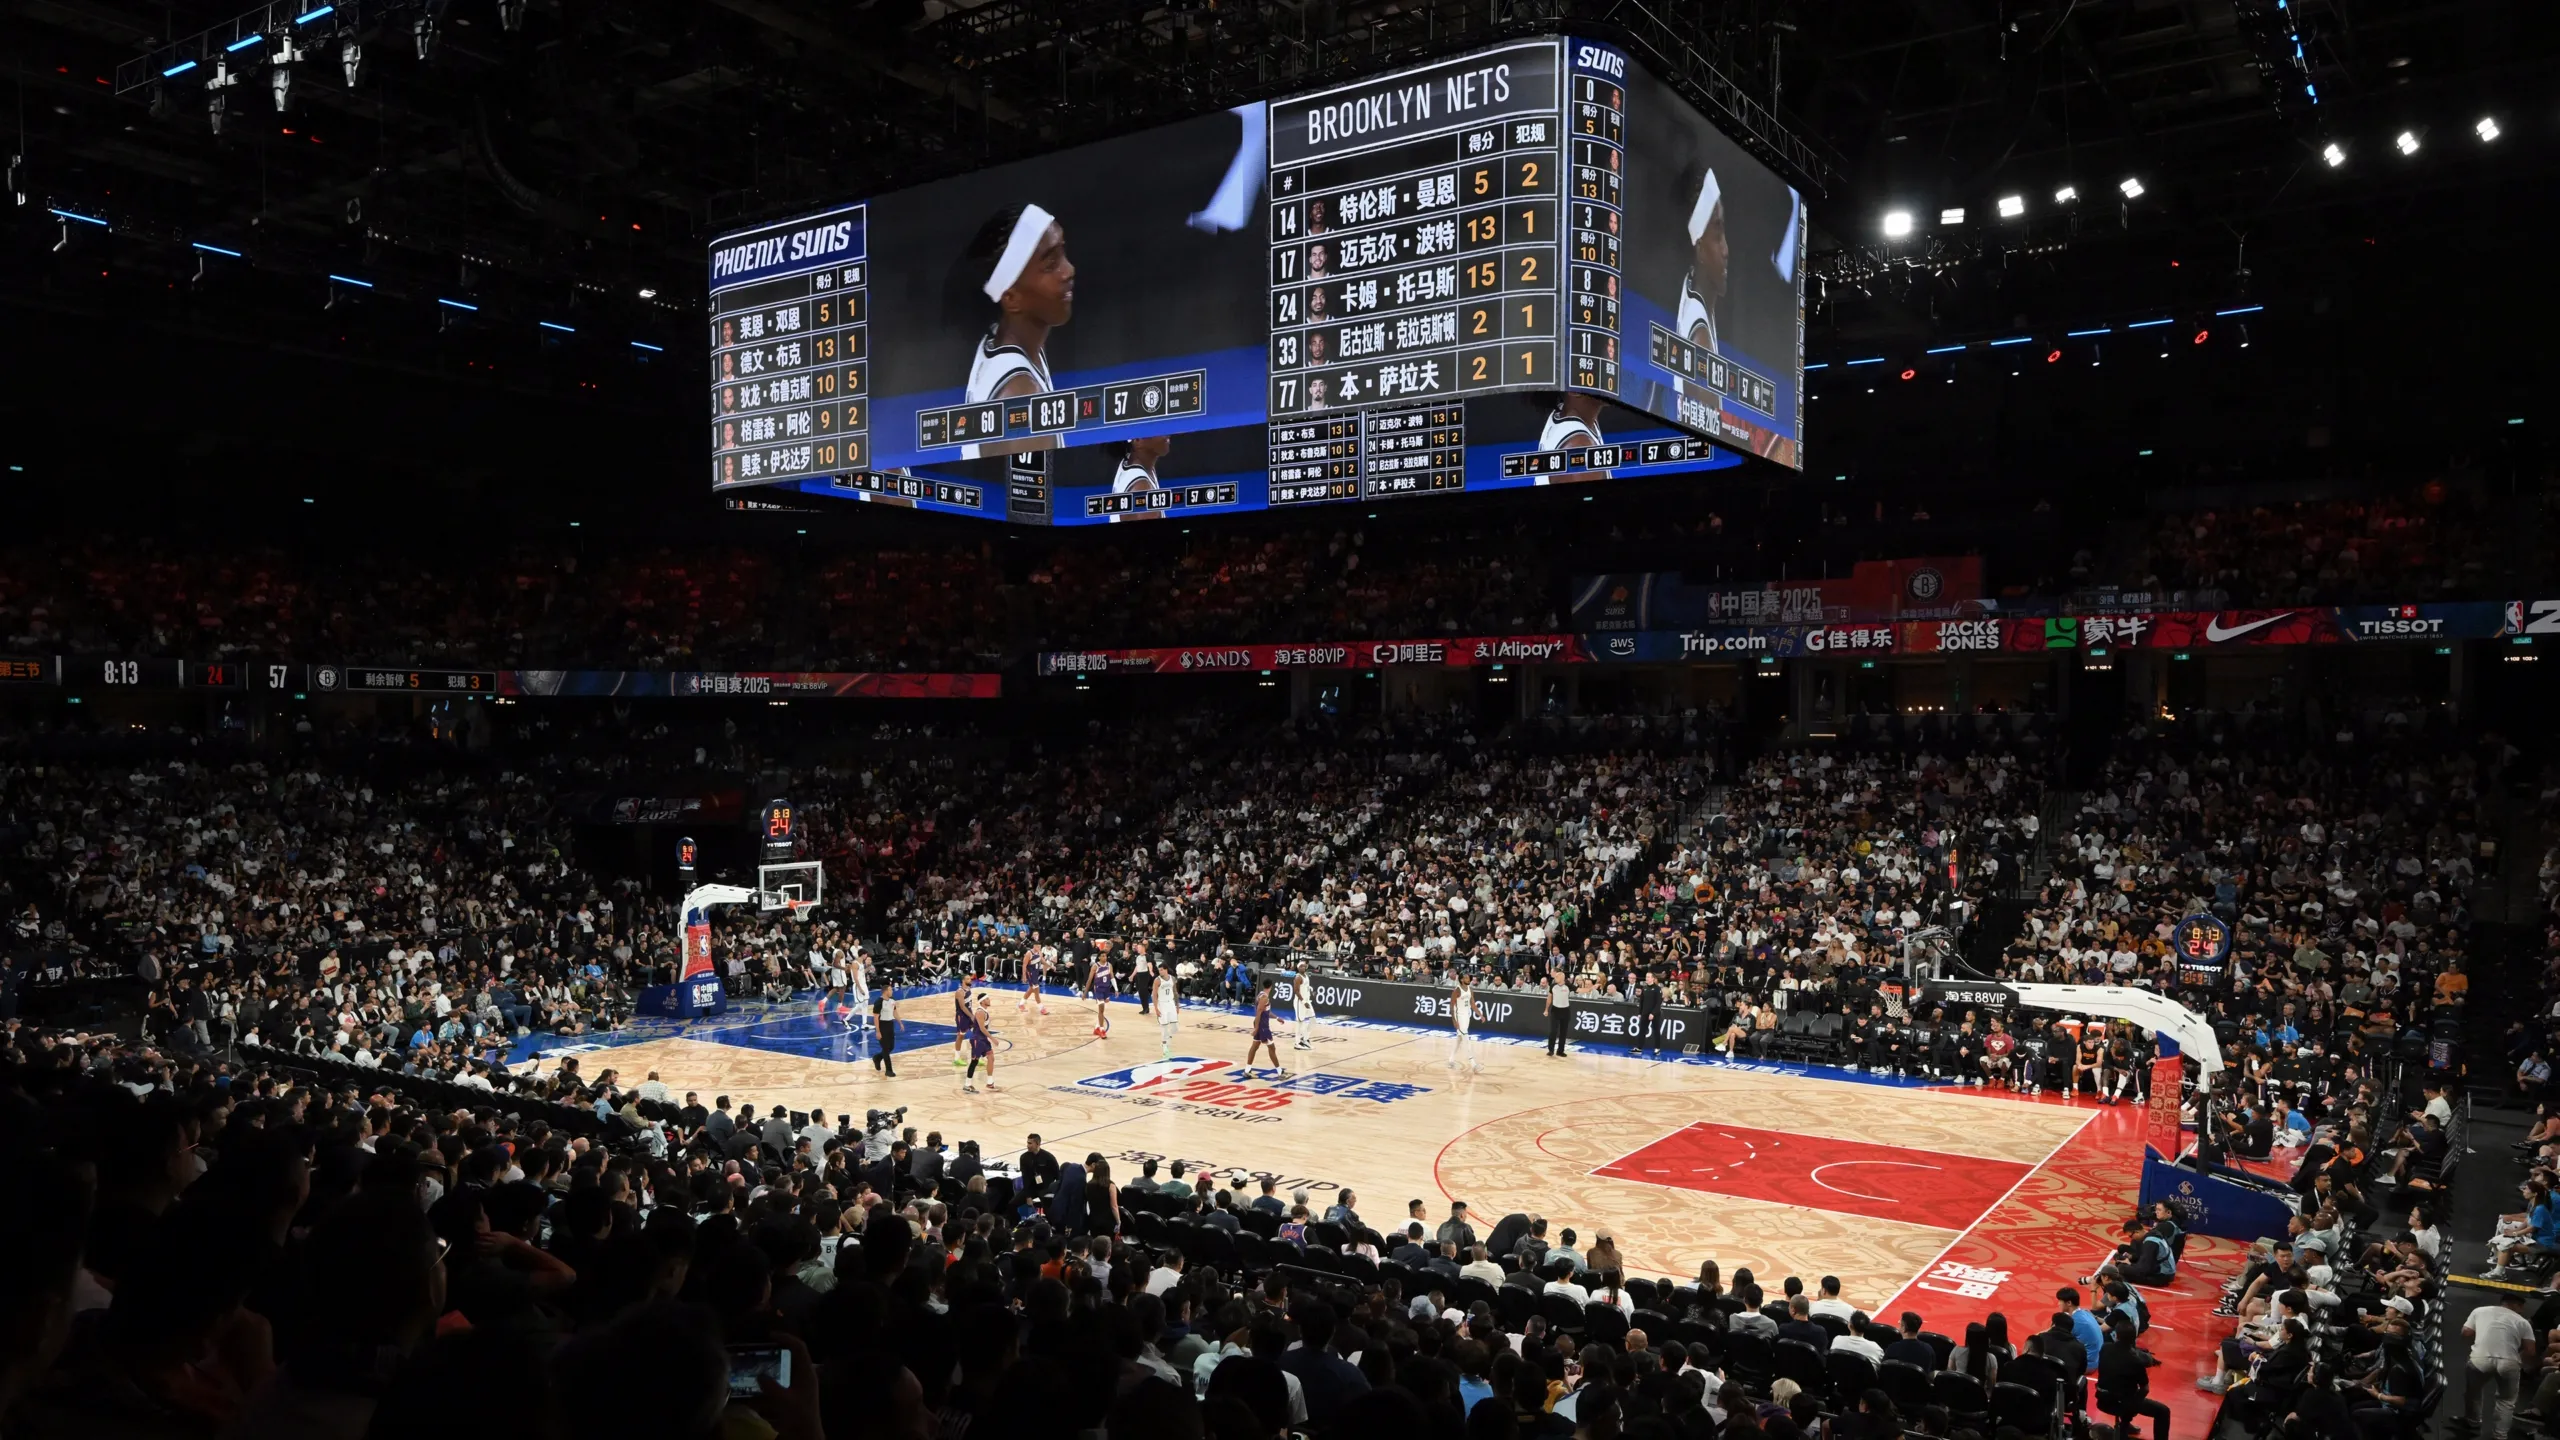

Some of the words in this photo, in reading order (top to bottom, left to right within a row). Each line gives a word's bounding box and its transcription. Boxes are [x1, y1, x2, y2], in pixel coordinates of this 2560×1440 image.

[1578, 46, 1624, 78] SUNS
[1587, 80, 1594, 101] 0
[1308, 82, 1430, 145] BROOKLYN
[1447, 64, 1510, 114] NETS
[1586, 120, 1594, 134] 5
[1284, 177, 1292, 190] #
[1468, 131, 1495, 153] 得分
[1516, 124, 1545, 144] 犯规
[1586, 144, 1591, 164] 1
[1280, 207, 1296, 234] 14
[1474, 171, 1488, 195] 5
[1522, 163, 1538, 186] 2
[1582, 184, 1597, 198] 13
[1585, 205, 1591, 227] 3
[1279, 251, 1295, 279] 17
[1468, 216, 1495, 242] 13
[1524, 210, 1534, 234] 1
[1581, 232, 1596, 245] 得分
[714, 235, 787, 279] PHOENIX
[791, 221, 851, 259] SUNS
[1580, 247, 1596, 261] 10
[1610, 253, 1616, 266] 5
[817, 274, 832, 289] 得分
[844, 268, 860, 284] 犯规
[1584, 270, 1590, 291] 8
[1279, 295, 1296, 321] 24
[1467, 263, 1495, 288] 15
[1521, 258, 1537, 281] 2
[820, 304, 829, 322] 5
[848, 299, 856, 316] 1
[1580, 295, 1594, 308] 得分
[1583, 310, 1591, 323] 9
[1609, 316, 1614, 329] 2
[1279, 338, 1296, 366] 33
[1473, 310, 1487, 334] 2
[1523, 305, 1533, 328] 1
[1582, 334, 1591, 353] 11
[816, 339, 834, 358] 13
[849, 335, 856, 352] 1
[1579, 358, 1594, 370] 得分
[817, 375, 835, 393] 10
[849, 370, 857, 388] 5
[1193, 382, 1198, 390] 5
[1279, 381, 1297, 409] 77
[1473, 358, 1487, 380] 2
[1522, 352, 1532, 374] 1
[1579, 372, 1594, 386] 10
[1608, 378, 1613, 391] 0
[1743, 377, 1748, 398] 57
[1193, 397, 1198, 405] 3
[821, 410, 830, 429] 9
[849, 406, 857, 425] 2
[981, 410, 994, 433] 60
[1041, 399, 1065, 426] 8:13
[1084, 401, 1092, 416] 24
[1114, 392, 1128, 415] 57
[1434, 414, 1445, 423] 13
[1452, 412, 1457, 421] 1
[1331, 425, 1342, 435] 13
[1349, 424, 1353, 433] 1
[1434, 434, 1445, 444] 15
[1452, 432, 1458, 442] 2
[817, 446, 835, 464] 10
[849, 442, 858, 460] 0
[1331, 445, 1342, 455] 10
[1349, 444, 1354, 453] 5
[1436, 456, 1442, 465] 2
[1452, 453, 1457, 462] 1
[1550, 456, 1560, 469] 60
[1594, 450, 1612, 466] 8:13
[1648, 446, 1658, 460] 57
[1334, 465, 1339, 475] 9
[1349, 464, 1354, 473] 2
[1331, 485, 1342, 495] 10
[1349, 484, 1354, 493] 0
[1436, 476, 1442, 486] 2
[1452, 474, 1456, 483] 1
[904, 482, 917, 496] 8:13
[941, 488, 947, 499] 57
[1152, 493, 1165, 507] 8:13
[1191, 490, 1198, 502] 57
[1937, 619, 1999, 635] JACK&
[2084, 617, 2147, 645] 蒙牛
[2360, 620, 2443, 633] TISSOT
[1610, 638, 1634, 648] aws
[1680, 634, 1766, 654] Trip.com
[1828, 629, 1892, 648] 佳得乐
[1936, 635, 1999, 650] JONES
[1196, 650, 1250, 667] SANDS
[1401, 644, 1442, 662] 阿里云
[104, 660, 138, 685] 8:13
[208, 666, 223, 685] 24
[269, 666, 287, 688] 57
[365, 672, 404, 688] 剩余暂停
[409, 673, 418, 688] 5
[448, 675, 466, 688] 犯规
[471, 676, 479, 690] 3
[639, 810, 679, 819] 2025
[774, 809, 789, 818] 8:13
[771, 819, 788, 836] 24
[683, 853, 691, 861] 24
[2192, 928, 2220, 941] 8:13
[2189, 940, 2214, 956] 24
[2191, 964, 2222, 972] TISSOT
[1273, 982, 1361, 1008] 淘88VIP
[1945, 990, 2007, 1004] 淘宝88VIP
[1414, 996, 1512, 1023] 淘宝8VIP
[1153, 1080, 1312, 1110] 2025
[2169, 1194, 2202, 1205] SANDS
